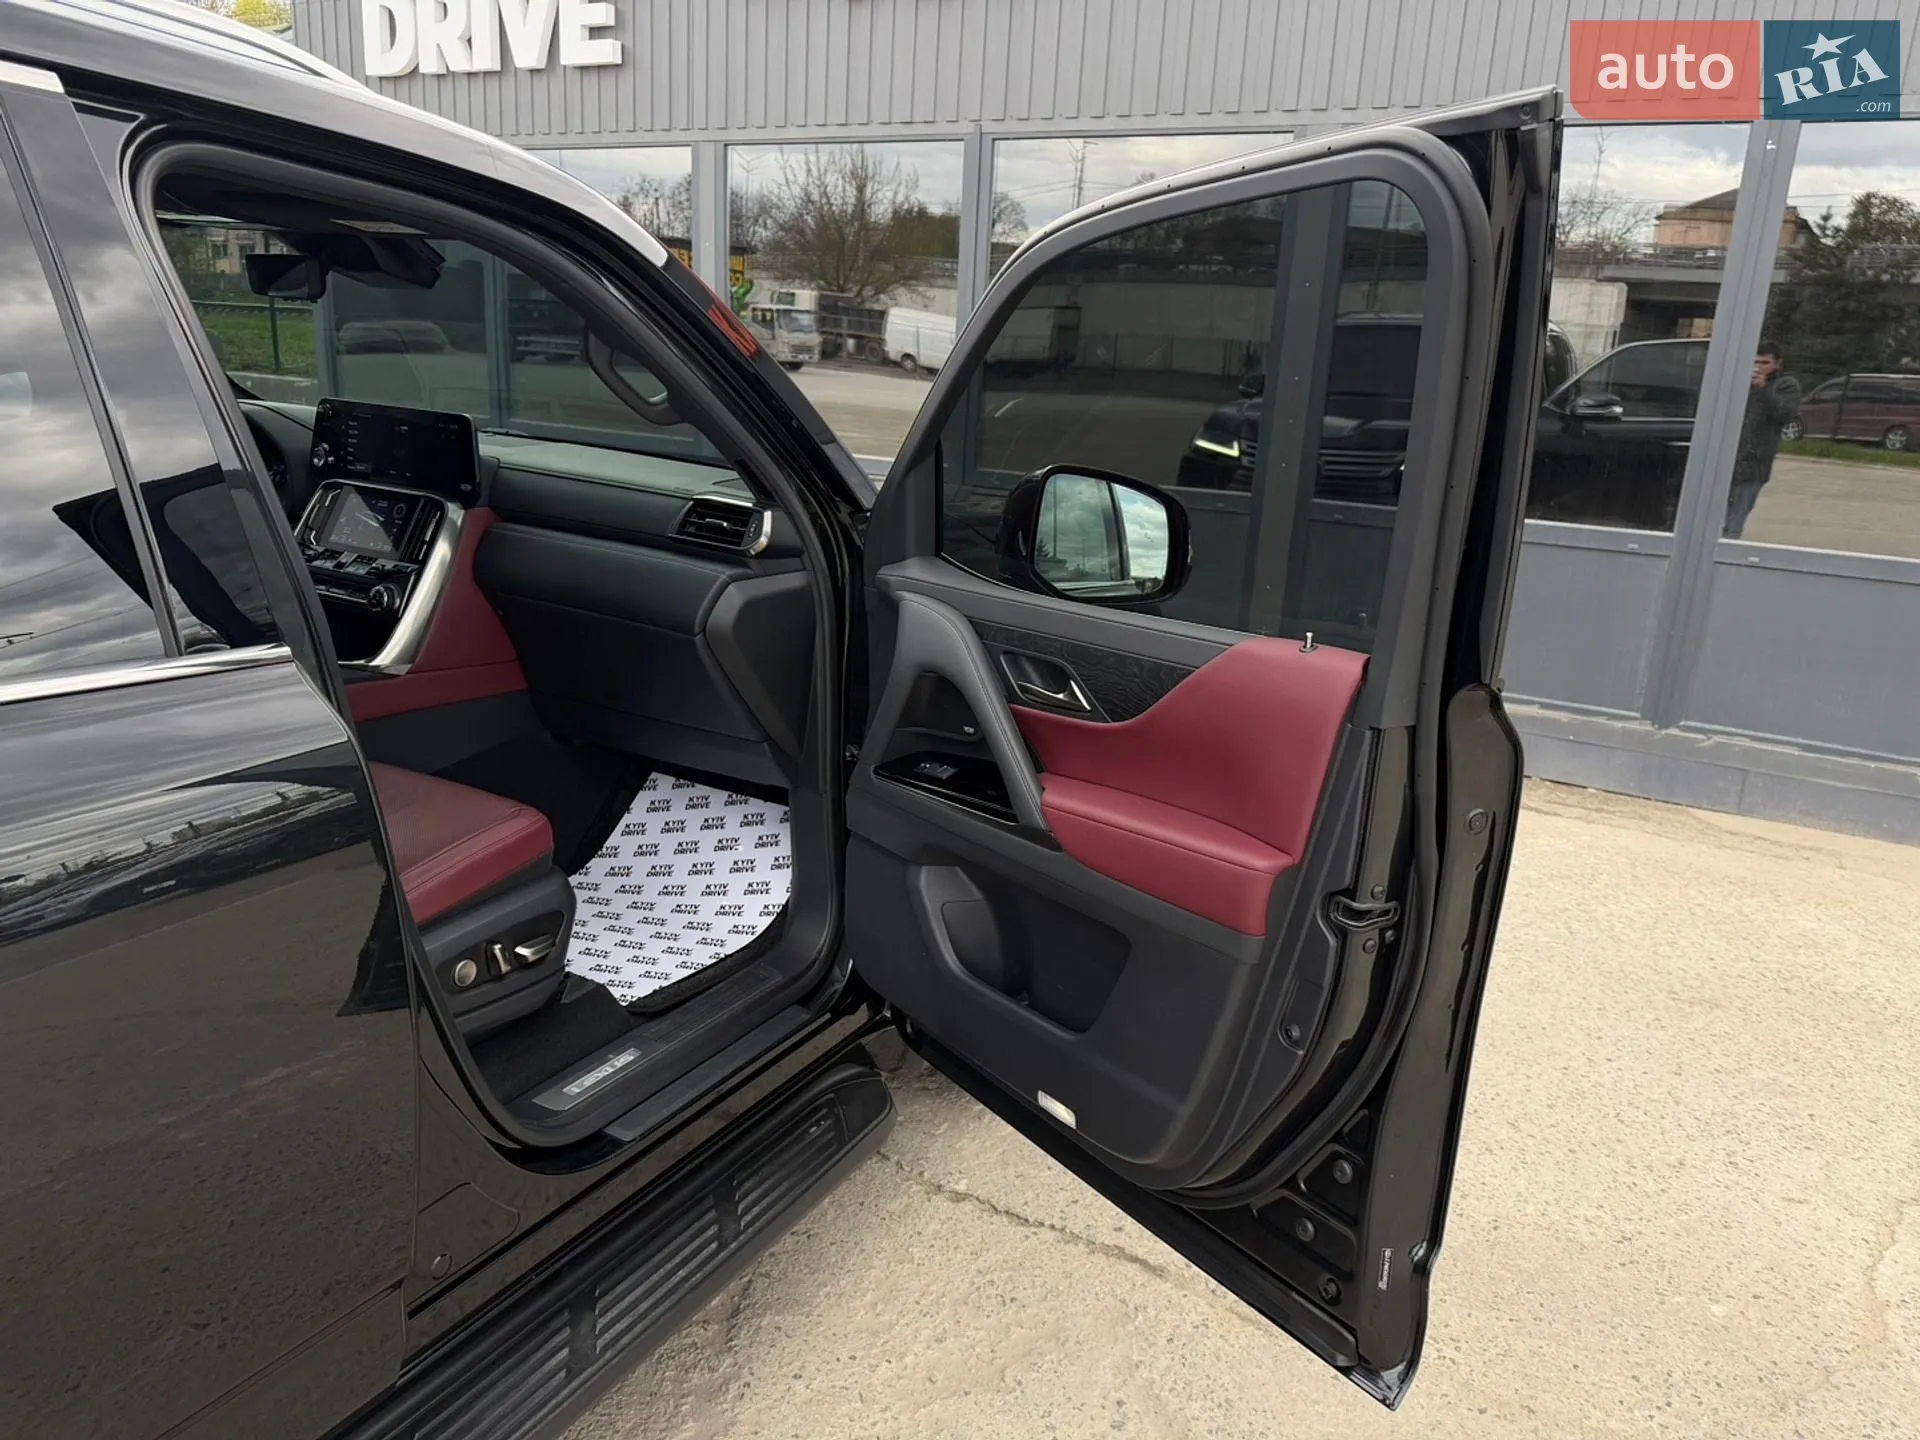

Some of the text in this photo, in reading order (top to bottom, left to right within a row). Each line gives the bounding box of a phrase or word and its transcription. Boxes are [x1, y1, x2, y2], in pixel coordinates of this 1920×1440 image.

[362, 0, 622, 77] DRIVE
[650, 798, 672, 806] KYIV
[688, 795, 710, 803] KYIV
[724, 798, 750, 806] DRIVE
[646, 805, 672, 813] DRIVE
[685, 801, 711, 810] DRIVE
[743, 812, 765, 820] KYIV
[664, 819, 686, 827] KYIV
[700, 823, 726, 831] DRIVE
[740, 819, 766, 828] DRIVE
[660, 826, 687, 834] DRIVE
[758, 833, 780, 841] KYIV
[678, 840, 700, 848] KYIV
[754, 840, 782, 848] DRIVE
[674, 847, 700, 856] DRIVE
[733, 858, 756, 866] KYIV
[771, 862, 792, 870] DRIV
[688, 868, 716, 876] DRIVE
[730, 866, 756, 874] DRIVE
